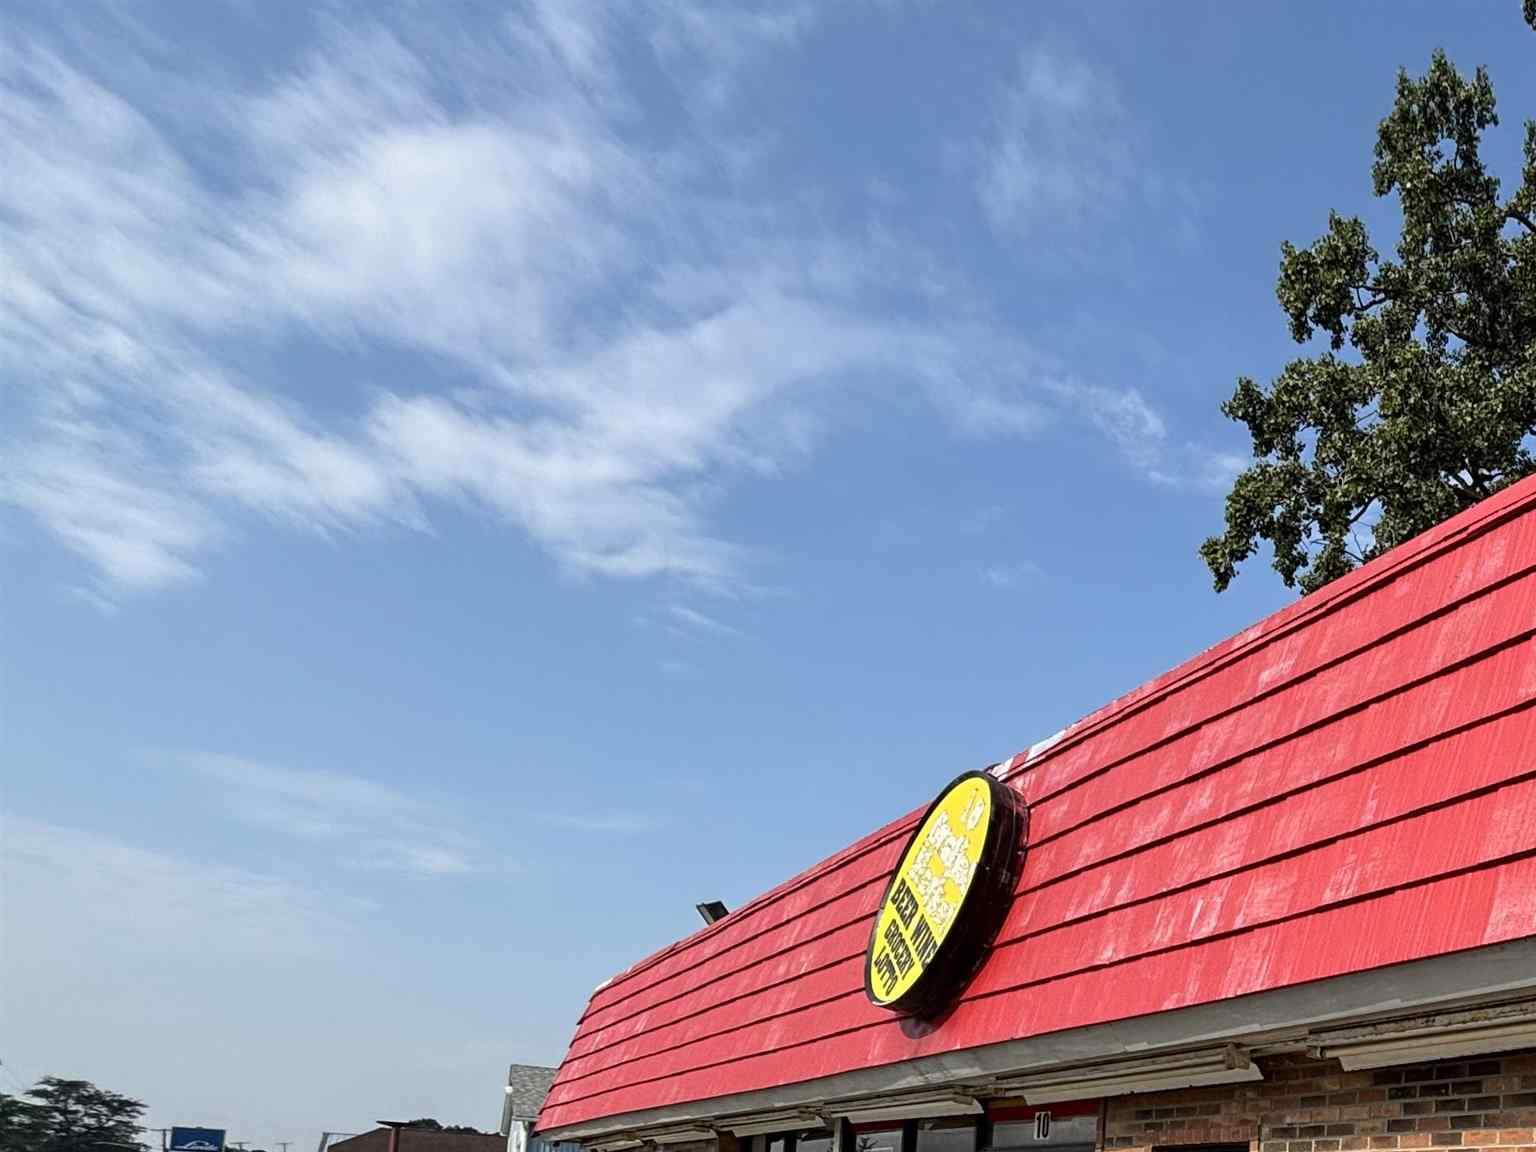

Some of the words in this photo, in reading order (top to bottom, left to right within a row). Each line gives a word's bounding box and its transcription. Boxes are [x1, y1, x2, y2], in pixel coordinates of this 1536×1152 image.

[891, 878, 918, 929] BEER
[874, 946, 898, 996] LOTTO
[885, 918, 915, 979] GROCERY
[1036, 1112, 1049, 1138] 10
